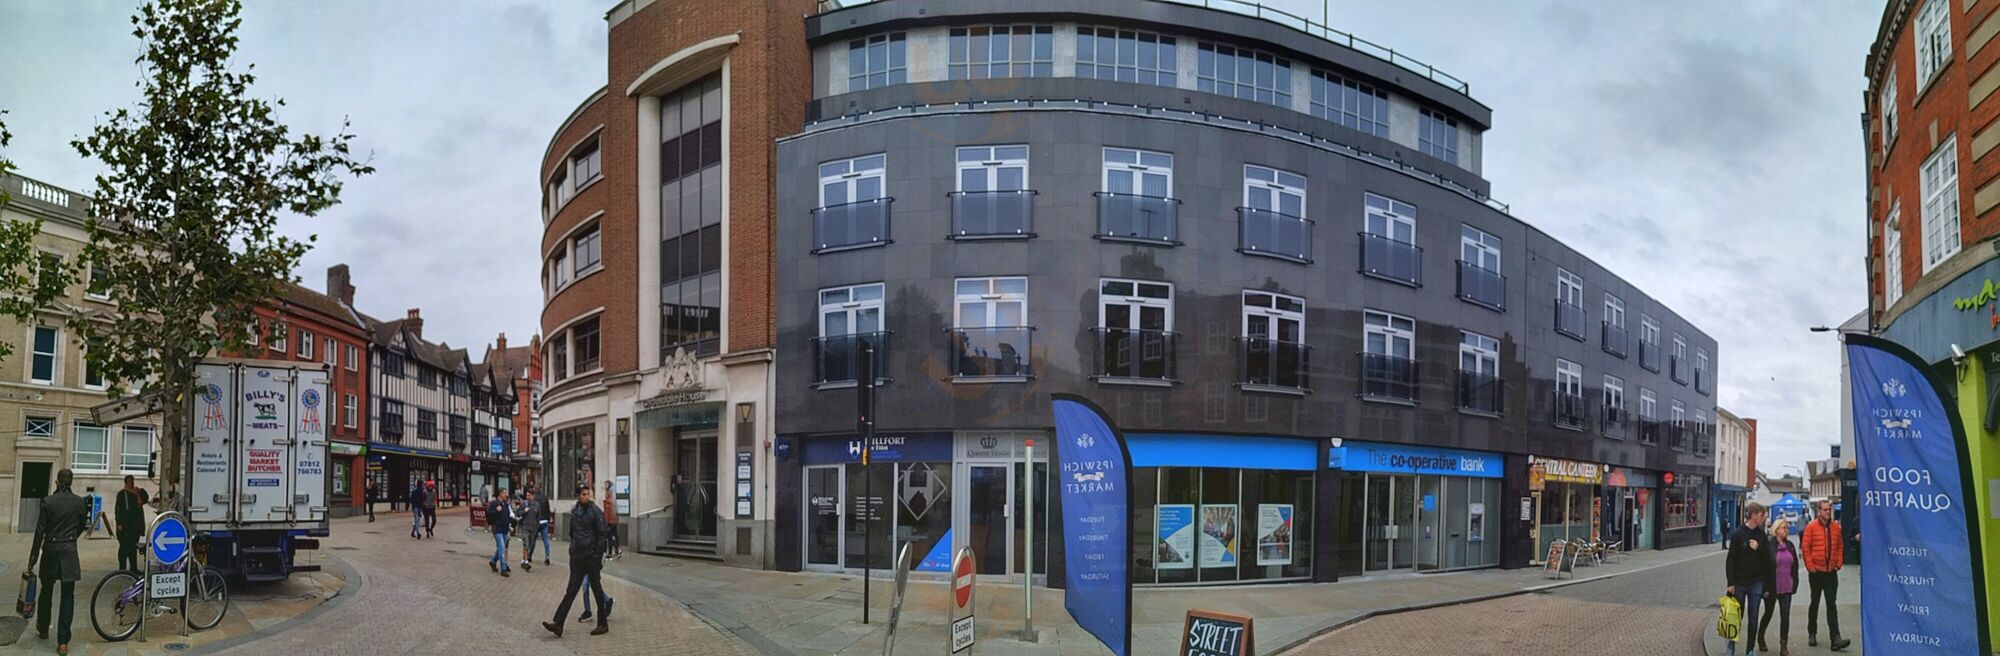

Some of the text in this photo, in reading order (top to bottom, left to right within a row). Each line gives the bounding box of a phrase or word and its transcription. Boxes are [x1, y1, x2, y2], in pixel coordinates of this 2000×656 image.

[245, 390, 287, 403] BILLY'S
[680, 387, 706, 402] House
[252, 422, 279, 430] MEATS
[1367, 448, 1387, 466] The
[1391, 454, 1457, 472] co-operative
[1460, 456, 1485, 473] bank
[156, 575, 182, 584] Except
[156, 585, 180, 596] cycles
[955, 620, 972, 634] Except
[1189, 619, 1244, 656] STREET
